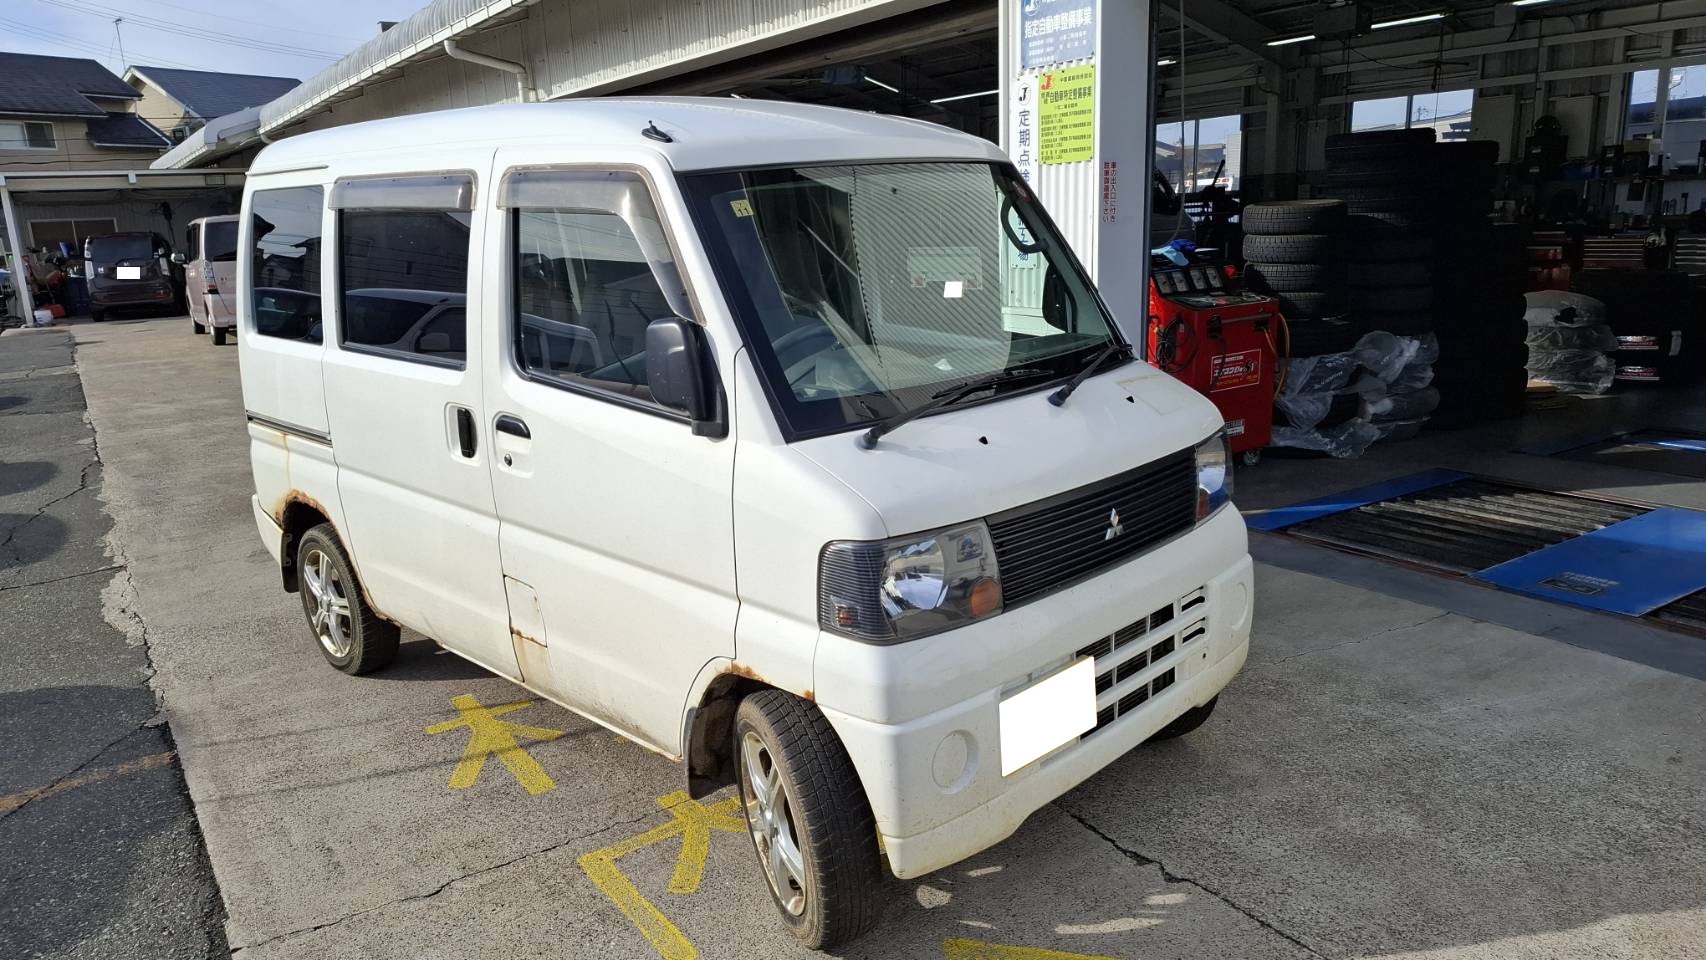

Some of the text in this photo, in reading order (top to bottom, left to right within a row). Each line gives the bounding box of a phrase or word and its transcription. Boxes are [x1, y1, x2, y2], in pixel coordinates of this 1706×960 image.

[1025, 6, 1092, 39] 指定自動車整備事業
